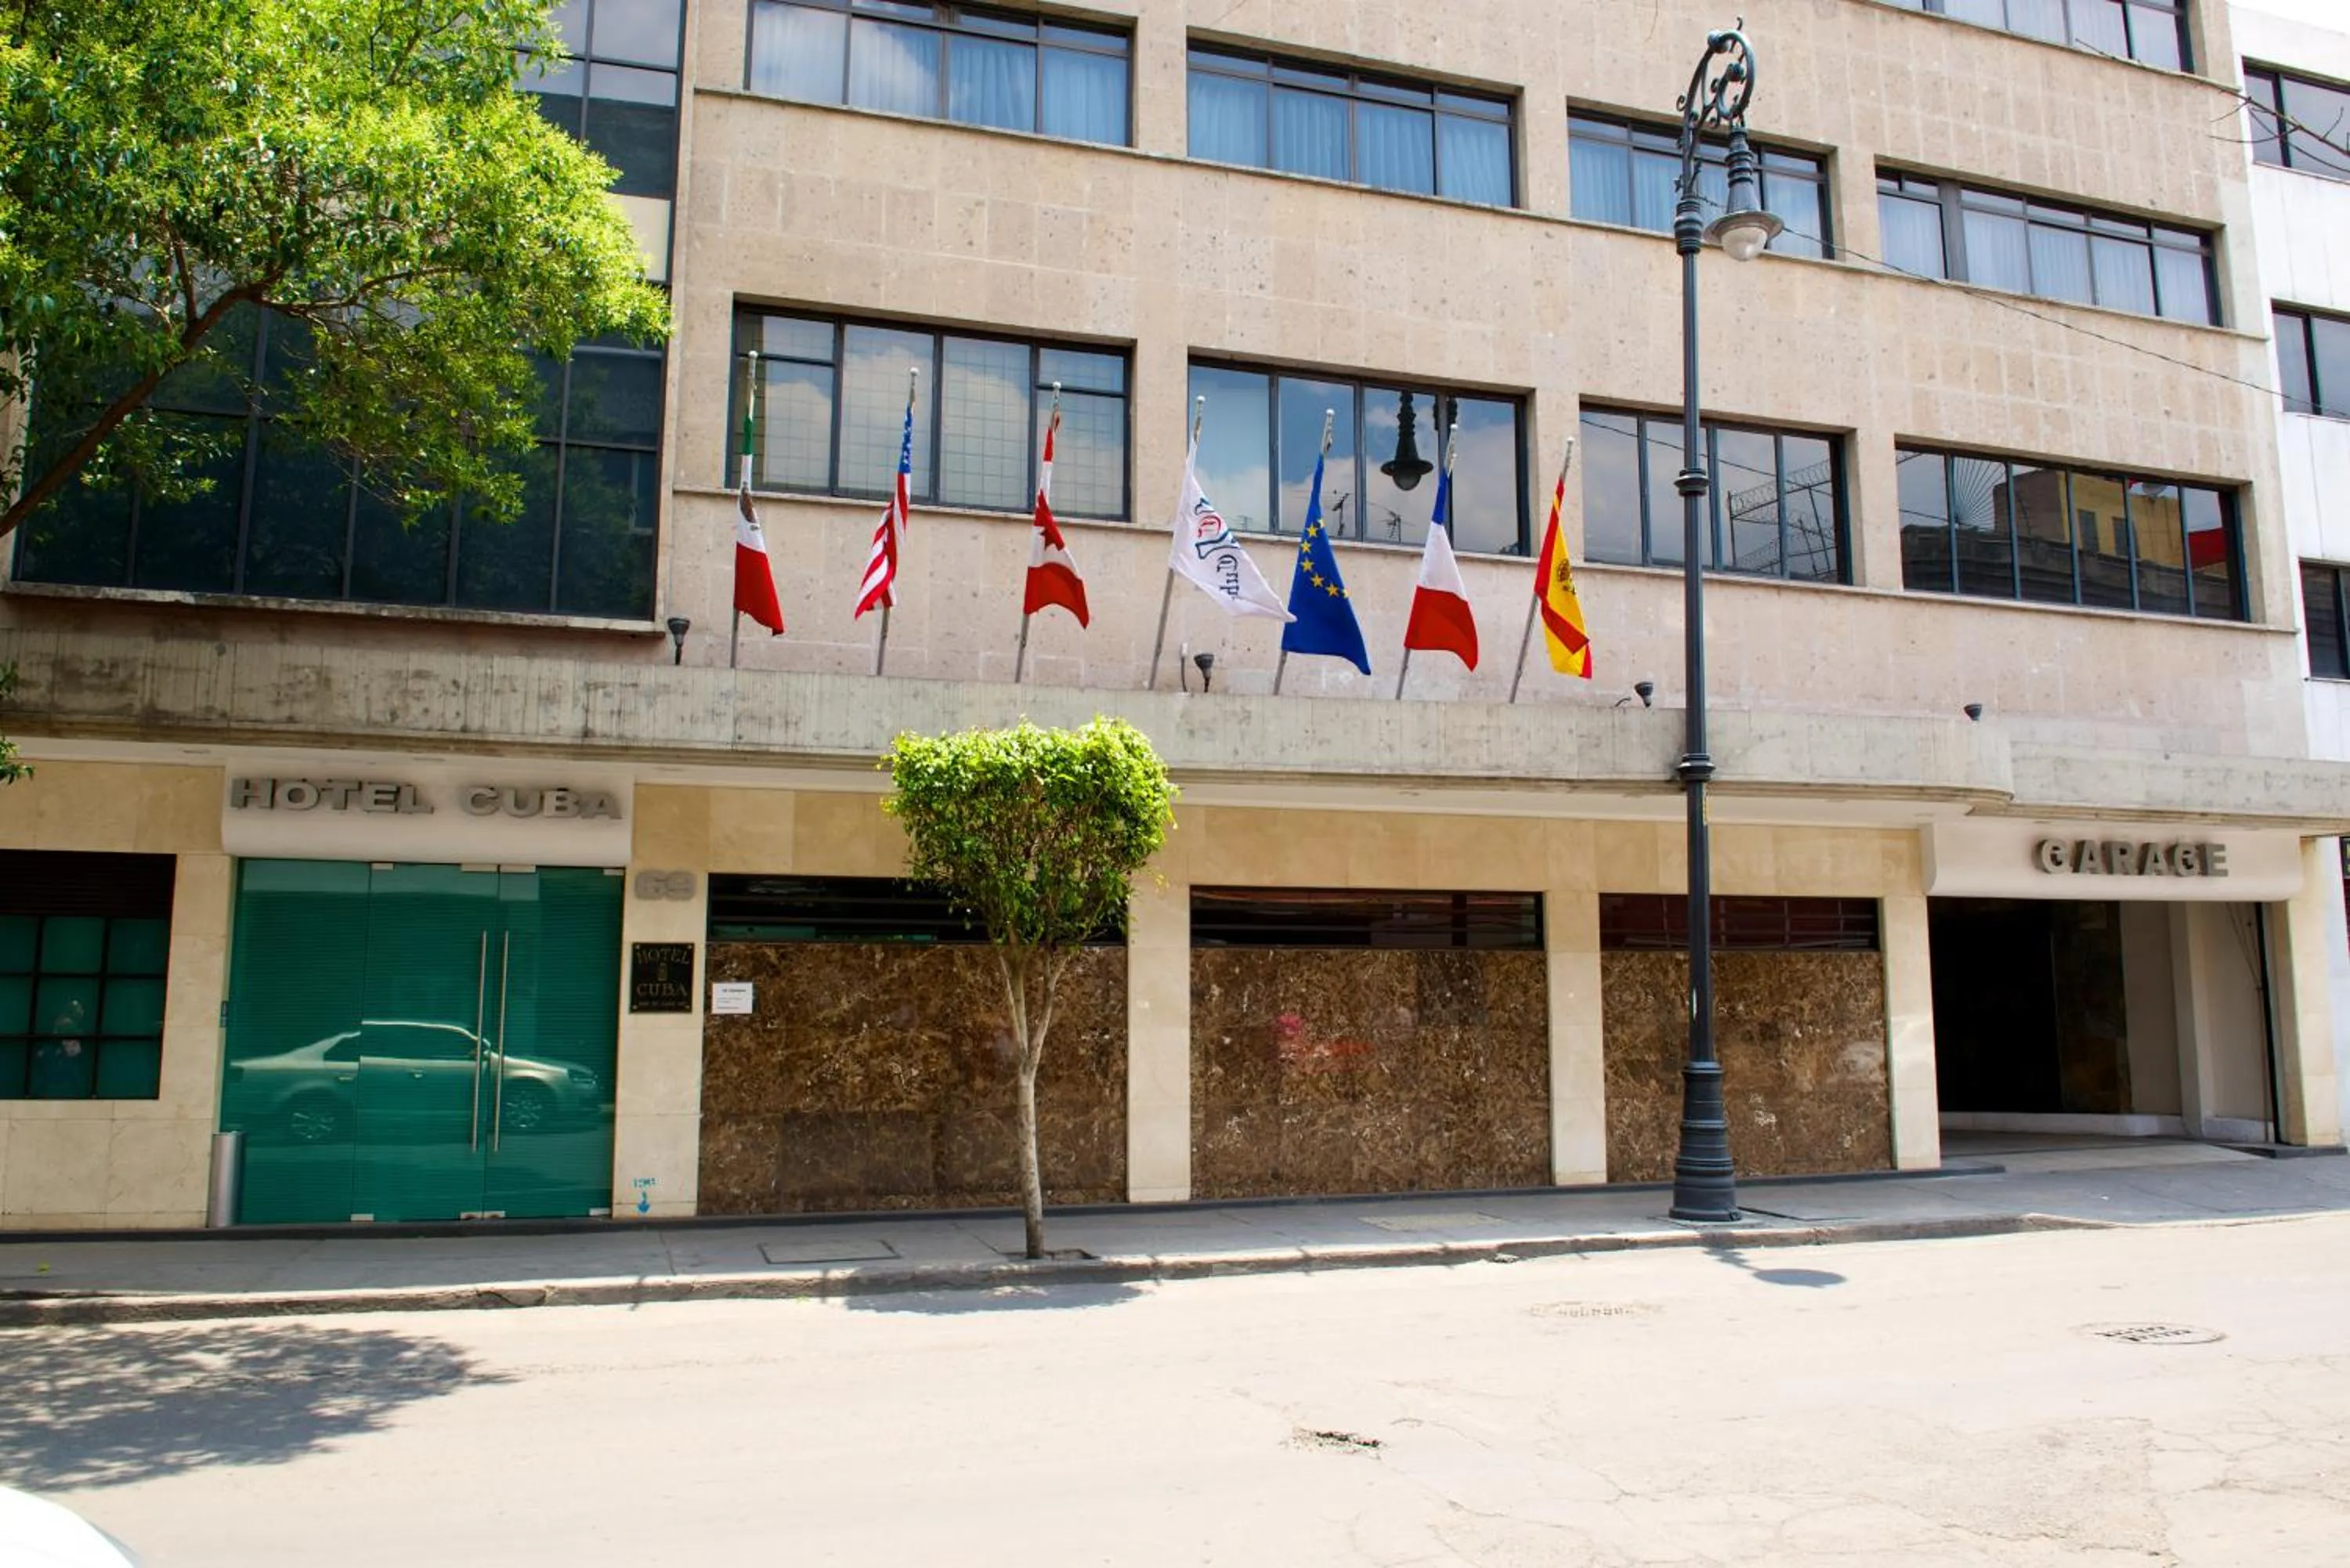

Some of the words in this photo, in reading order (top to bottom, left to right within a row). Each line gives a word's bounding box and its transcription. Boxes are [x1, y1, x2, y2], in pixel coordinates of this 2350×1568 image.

[230, 778, 435, 815] HOTEL
[462, 786, 624, 820] CUBA
[2033, 838, 2229, 878] GARAGE
[636, 948, 690, 965] HOTEL
[636, 981, 689, 997] CUBA
